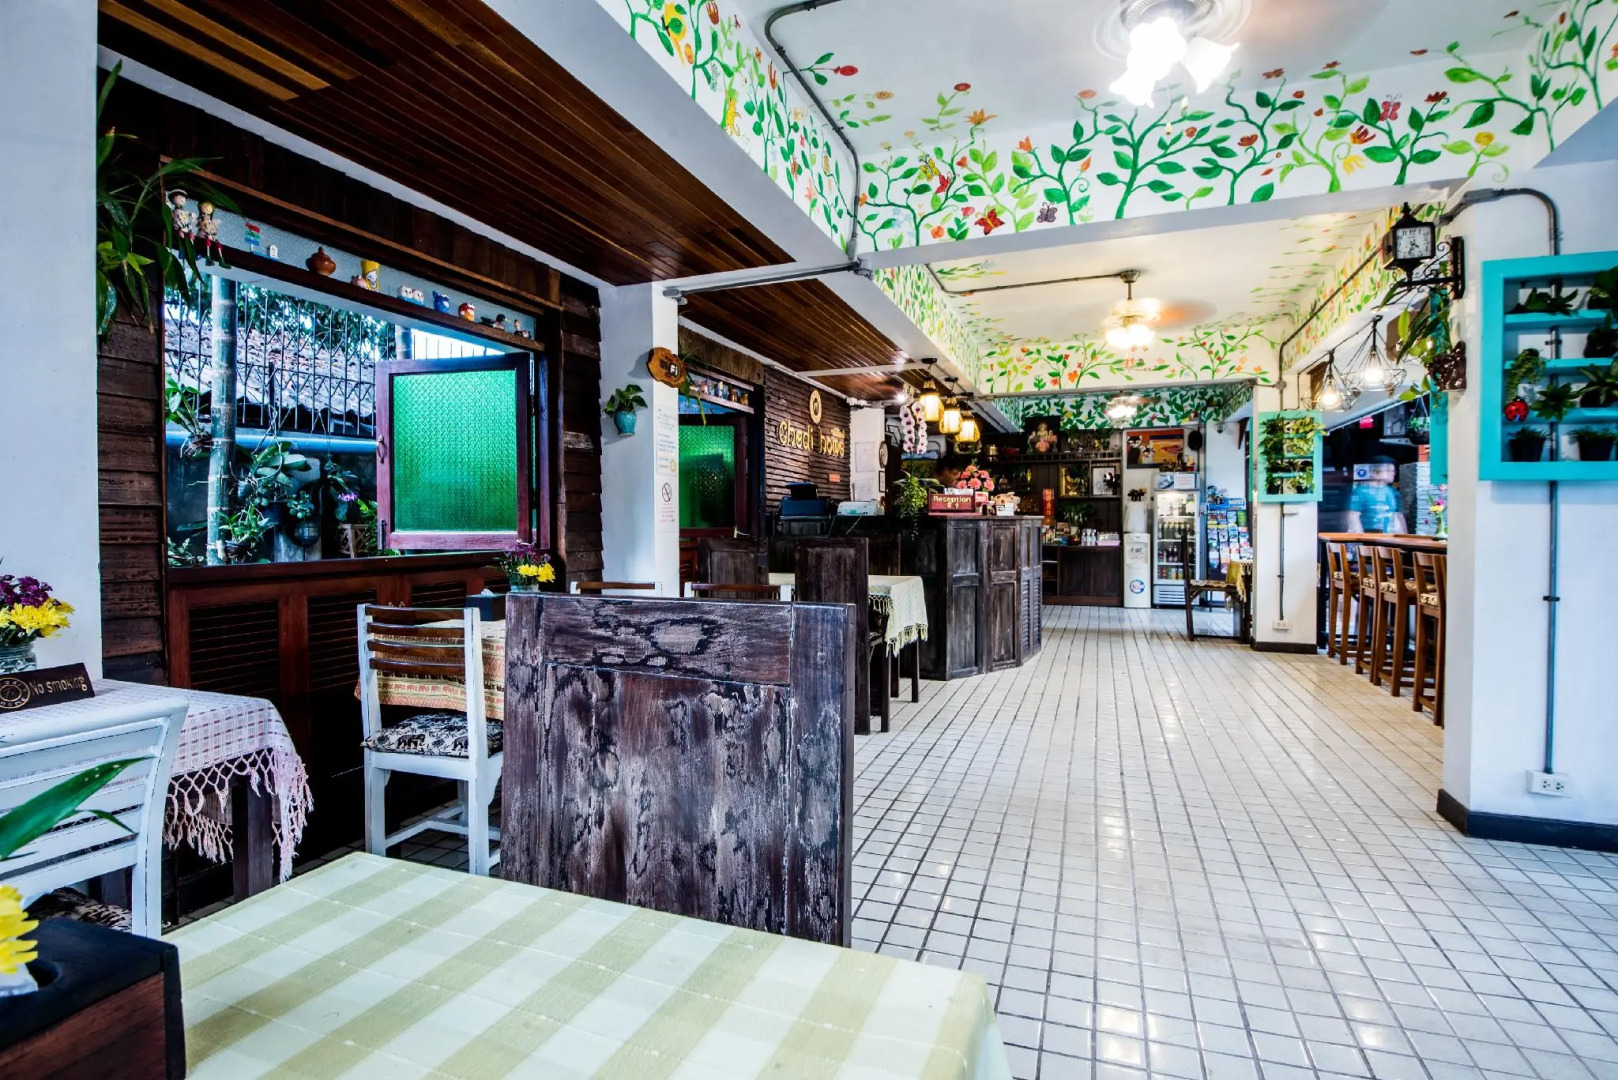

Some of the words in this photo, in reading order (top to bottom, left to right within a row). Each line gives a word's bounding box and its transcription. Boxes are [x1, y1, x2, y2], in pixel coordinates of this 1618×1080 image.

[933, 495, 972, 503] Reception
[29, 680, 45, 696] No
[46, 675, 88, 692] smoking
